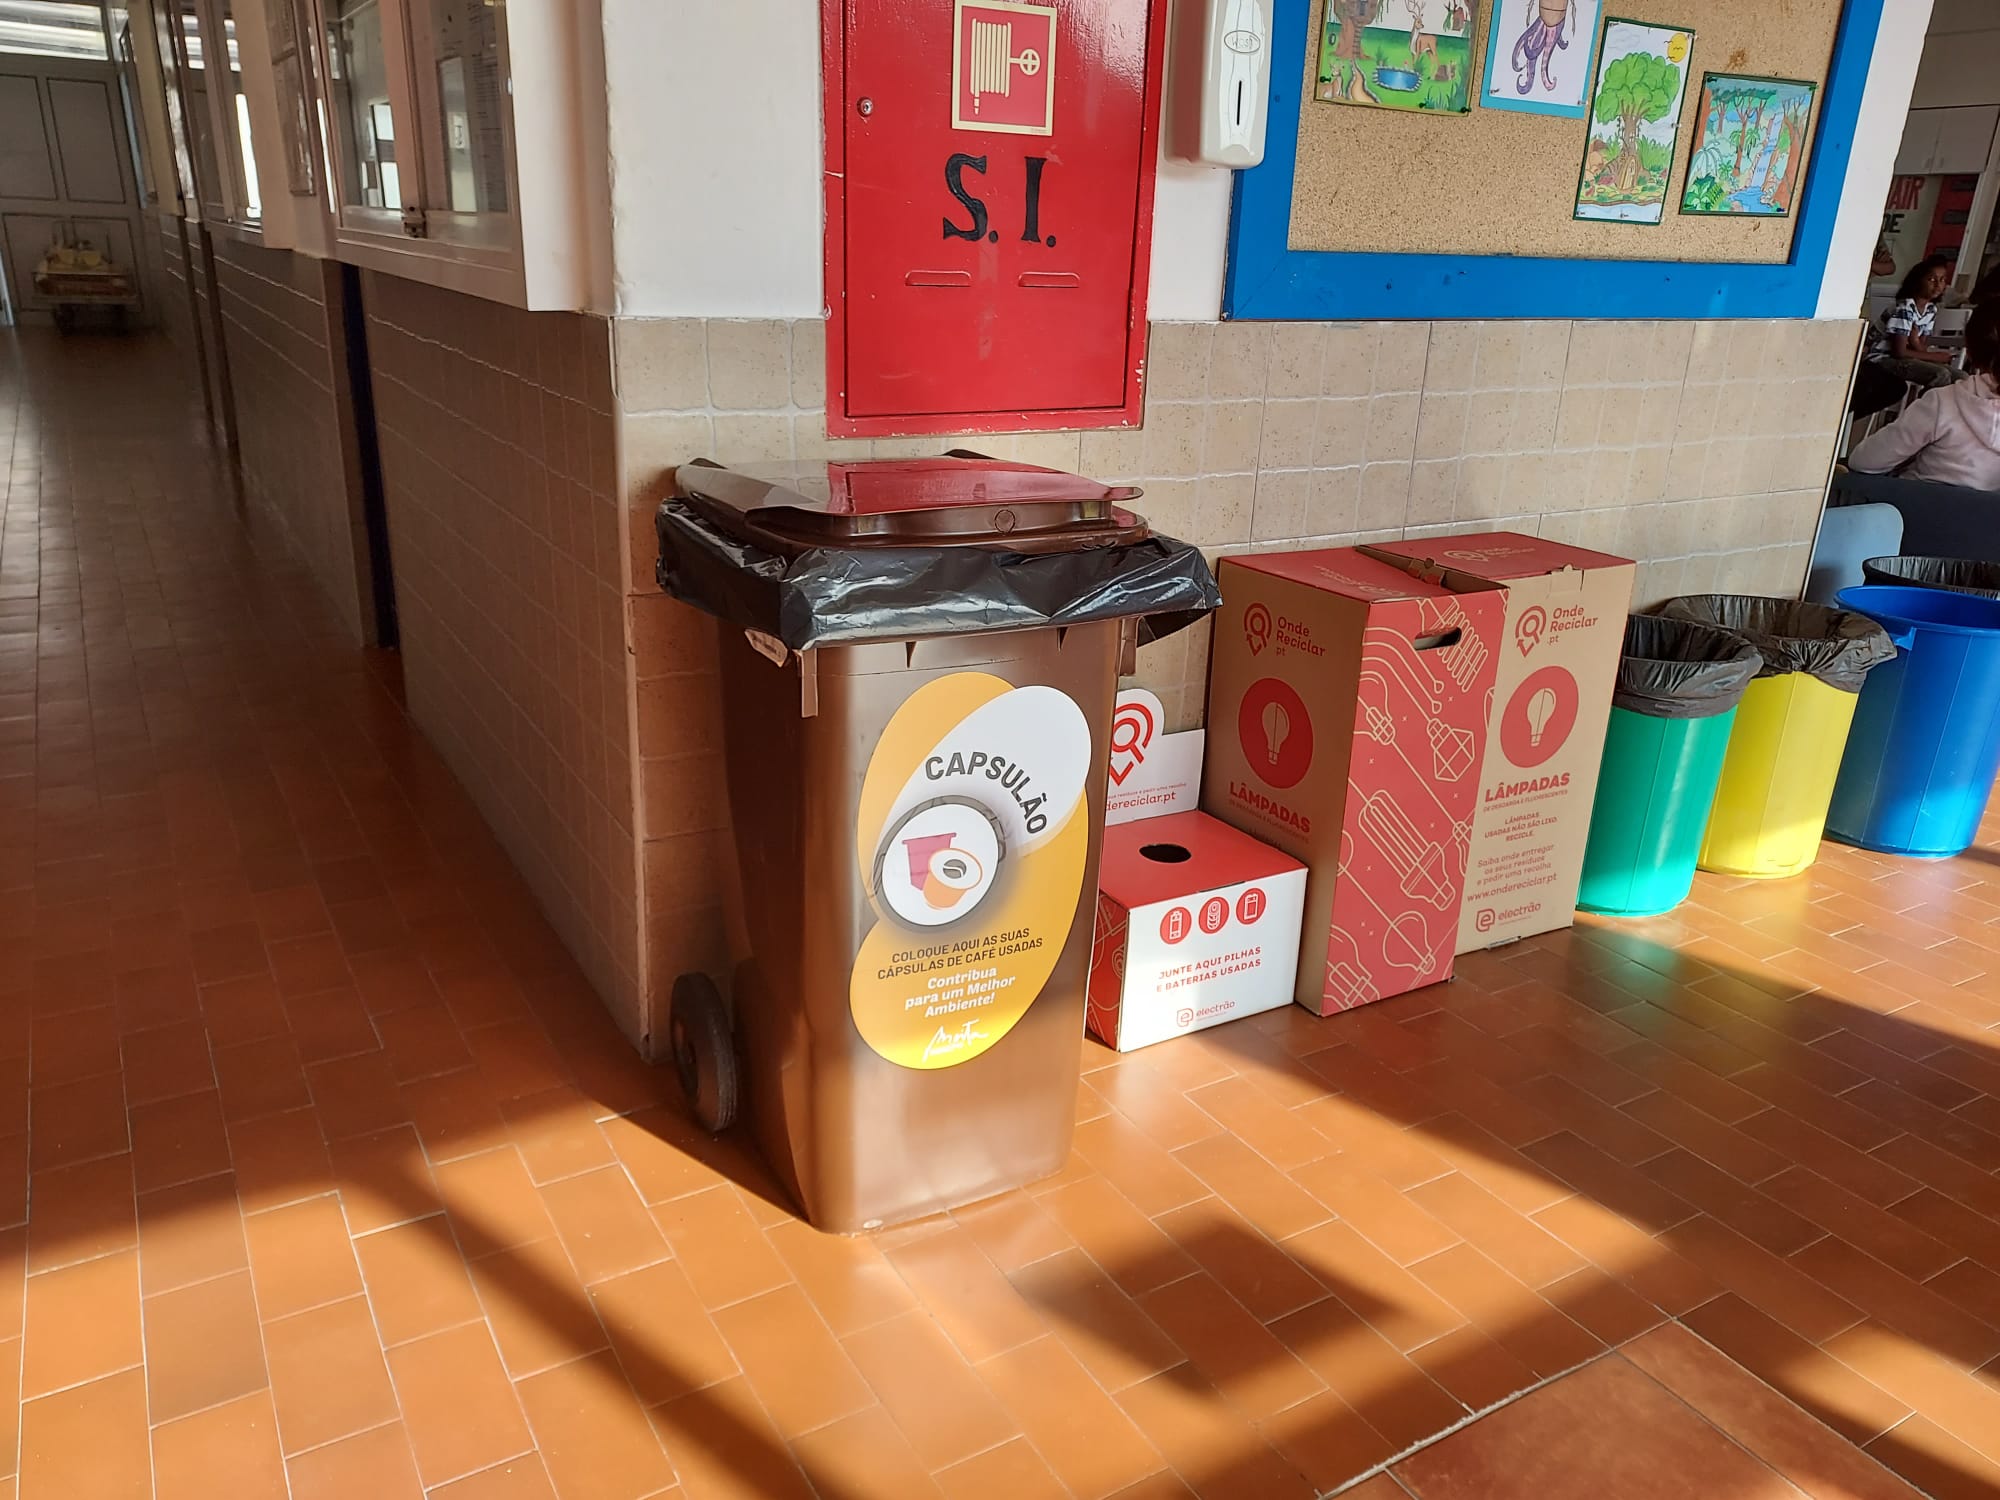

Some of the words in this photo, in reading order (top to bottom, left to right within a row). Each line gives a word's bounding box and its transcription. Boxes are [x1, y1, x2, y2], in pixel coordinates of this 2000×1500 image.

[1549, 616, 1598, 632] Reciclar
[1553, 604, 1584, 619] Onde
[1278, 616, 1309, 636] Onde
[1276, 630, 1325, 656] Reciclar
[925, 752, 1047, 834] CAPSULÃO
[1485, 772, 1570, 802] LÂMPADAS
[1230, 781, 1310, 832] LÂMPADAS
[1504, 812, 1539, 824] LÂMPADAS
[1485, 827, 1511, 838] USADAS
[1512, 822, 1526, 832] NÃO
[1527, 819, 1540, 828] SÃO
[1478, 857, 1499, 868] Saiba
[1501, 852, 1520, 862] onde
[1521, 844, 1554, 856] entregar
[1495, 863, 1512, 872] seus
[1483, 873, 1503, 885] pedir
[1505, 870, 1522, 878] uma
[1524, 862, 1551, 873] recolha
[1467, 873, 1557, 902] www.ondereciclar.pt
[1498, 902, 1541, 921] electrão
[892, 944, 949, 963] COLOQUE
[952, 938, 980, 953] AQUI
[982, 935, 998, 947] AS
[1000, 928, 1030, 943] SUAS
[878, 959, 944, 979] CÁPSULAS
[947, 955, 963, 966] DE
[965, 947, 996, 963] CAFÉ
[998, 938, 1043, 956] USADAS
[1158, 965, 1193, 979] JUNTE
[1195, 957, 1221, 970] AQUI
[1224, 946, 1261, 963] PILHAS
[927, 967, 997, 989] Contribua
[1165, 970, 1218, 991] BATERIAS
[1220, 959, 1261, 976] USADAS
[904, 995, 939, 1010] para
[942, 988, 963, 1000] um
[967, 976, 1016, 996] Melhor
[924, 992, 995, 1018] Ambiente!
[1196, 1000, 1235, 1017] electrão
